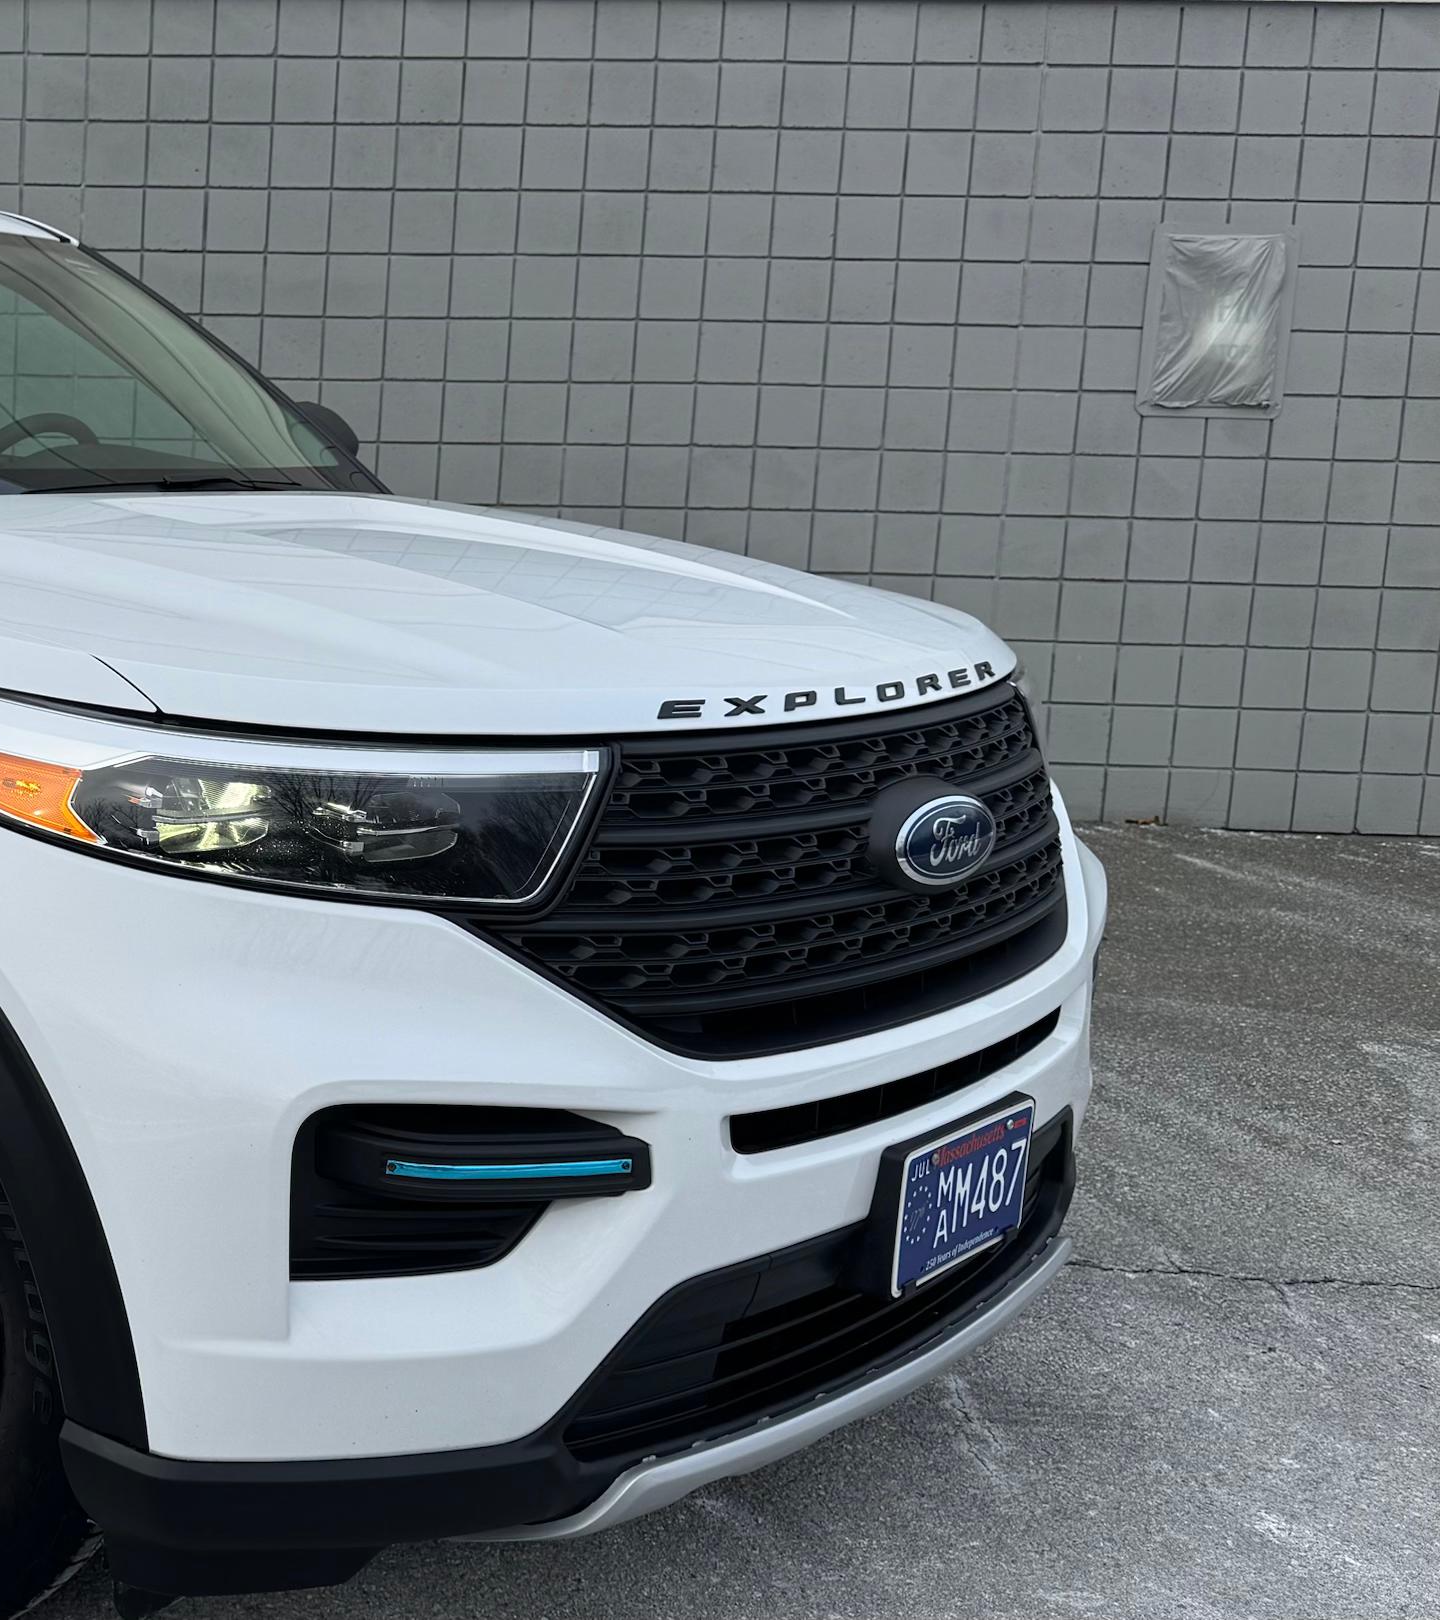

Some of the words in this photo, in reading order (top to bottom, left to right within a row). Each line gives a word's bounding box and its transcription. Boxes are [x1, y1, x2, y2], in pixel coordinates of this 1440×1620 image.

[657, 661, 996, 720] EXPLORER
[929, 814, 981, 867] Ford
[936, 1123, 1006, 1167] Massachusetts
[911, 1159, 931, 1182] JUL
